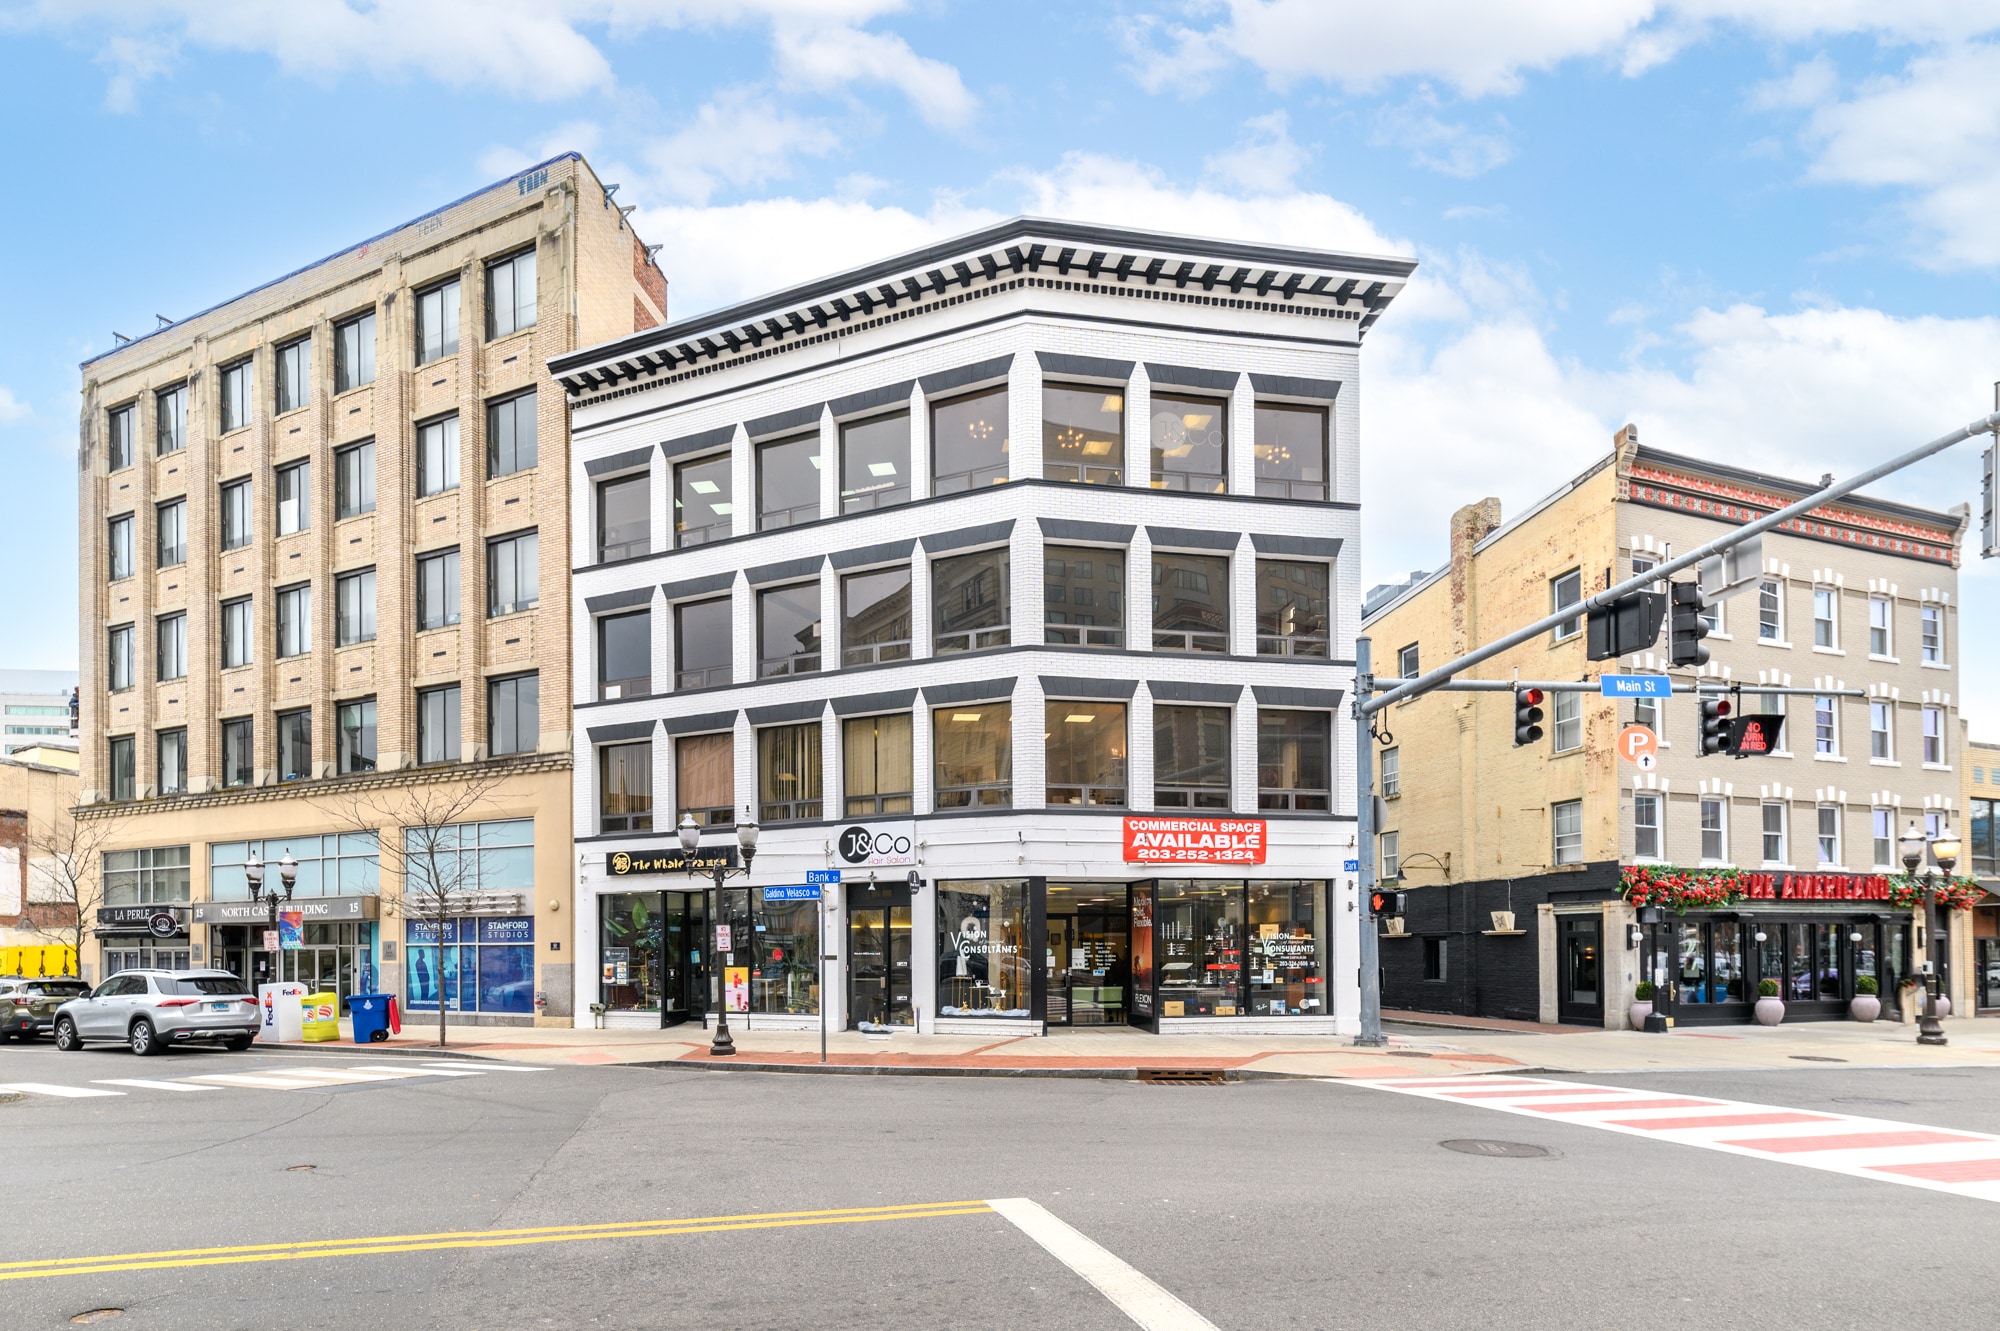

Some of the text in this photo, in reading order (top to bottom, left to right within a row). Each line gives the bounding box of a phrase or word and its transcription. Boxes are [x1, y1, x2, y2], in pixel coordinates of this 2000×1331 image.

[1616, 680, 1656, 692] Main St
[1629, 733, 1649, 756] P
[1750, 741, 1767, 751] RED
[1129, 820, 1262, 833] COMMERCIAL SPACE
[847, 832, 911, 857] J&Co
[1132, 832, 1260, 849] AVAILABLE
[1137, 849, 1255, 860] 203-252-1324
[632, 859, 650, 871] The
[653, 858, 684, 870] Whale
[868, 856, 911, 865] Hair Salon
[808, 872, 830, 883] Bank
[786, 887, 810, 898] Velasco
[195, 908, 204, 918] 15
[221, 904, 329, 918] NORTH CASE BUILDING
[349, 902, 359, 913] 15
[114, 910, 124, 920] LA
[126, 909, 150, 920] PERLE
[488, 921, 529, 930] STAMFORD
[415, 931, 452, 939] STUDOS
[488, 931, 529, 939] STUDIOS
[950, 930, 987, 951] VISION
[1260, 932, 1290, 949] VISION
[959, 940, 1018, 959] CONSULTANTS
[1267, 940, 1315, 957] CONSULTANTS
[282, 988, 303, 996] FedEx
[1135, 993, 1152, 1004] FLEXON
[264, 991, 274, 1027] FedEx
